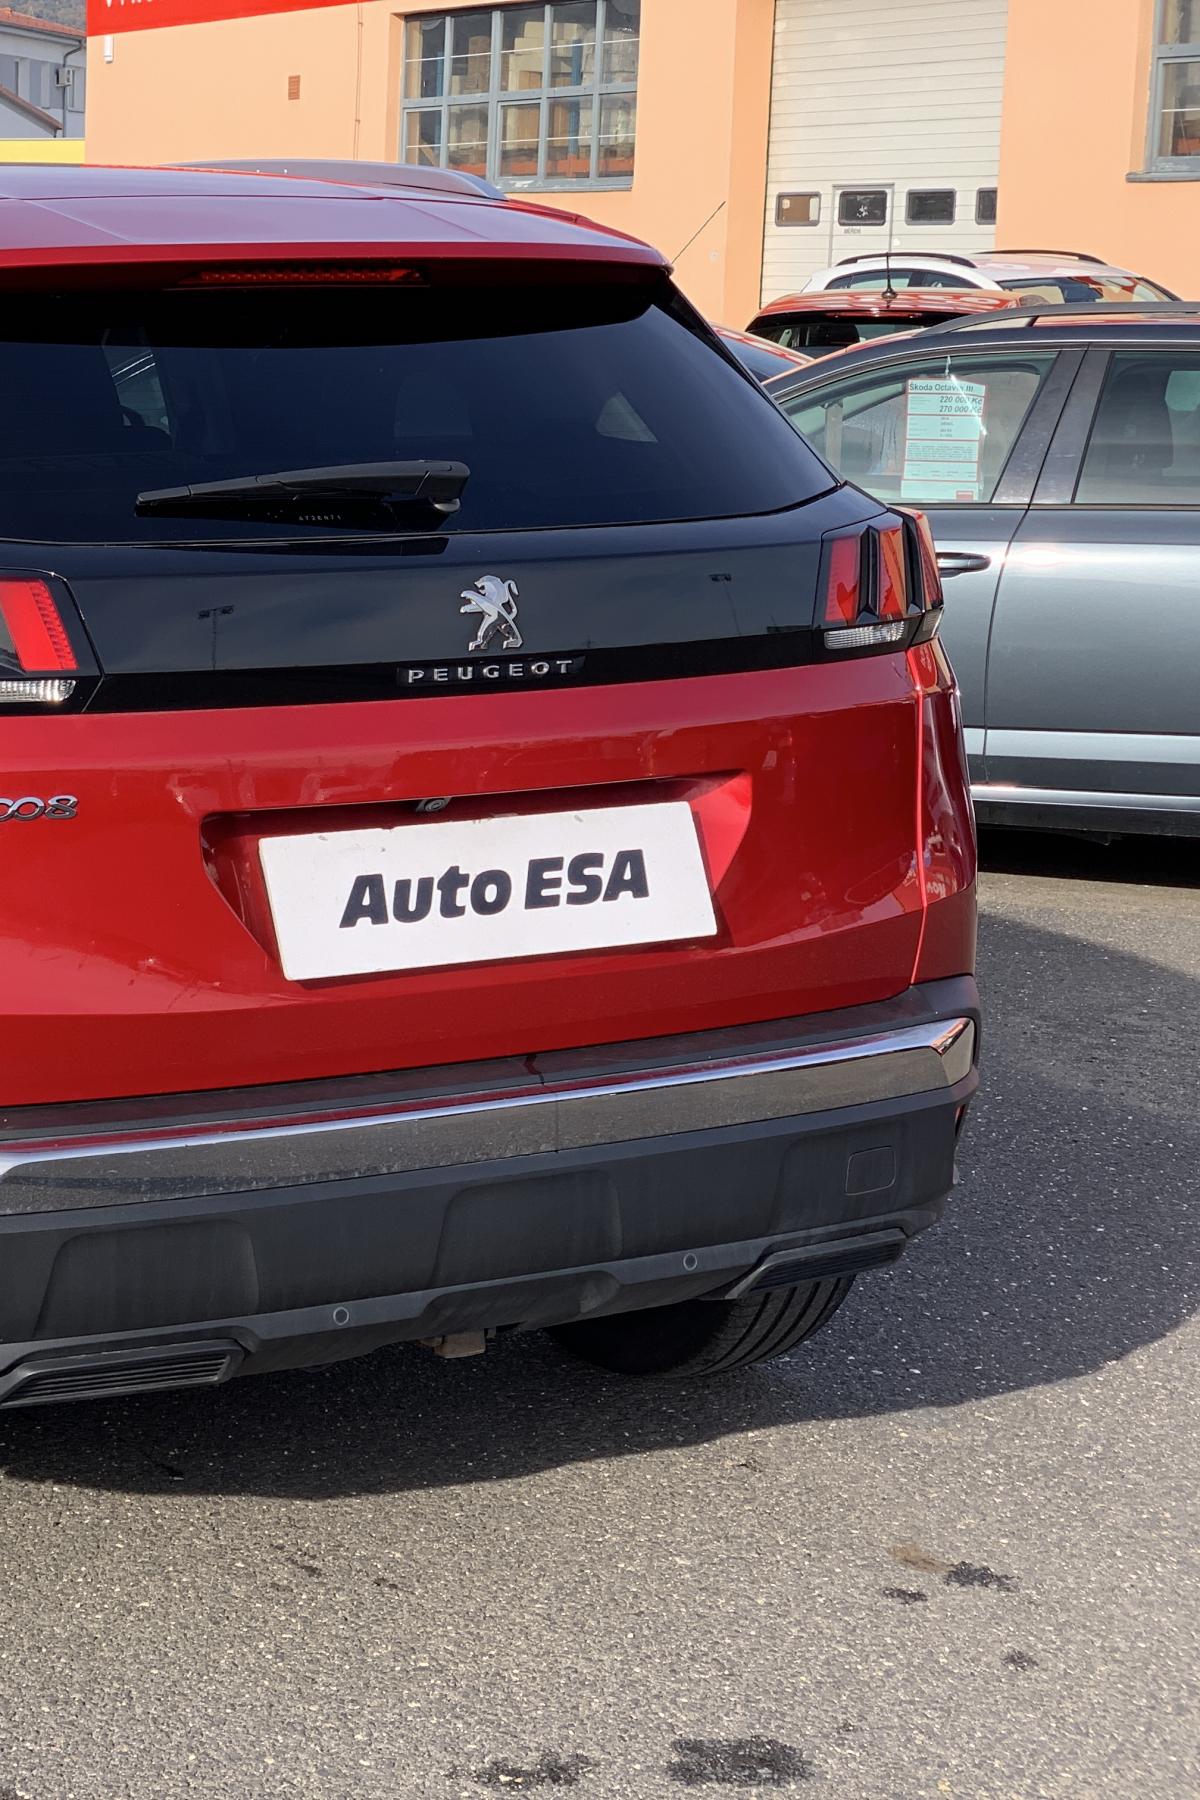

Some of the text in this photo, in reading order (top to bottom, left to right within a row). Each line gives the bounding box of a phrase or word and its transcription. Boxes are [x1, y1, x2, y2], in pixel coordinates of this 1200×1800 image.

[407, 660, 573, 683] PEUGEOT
[338, 849, 650, 928] Auto ESA
